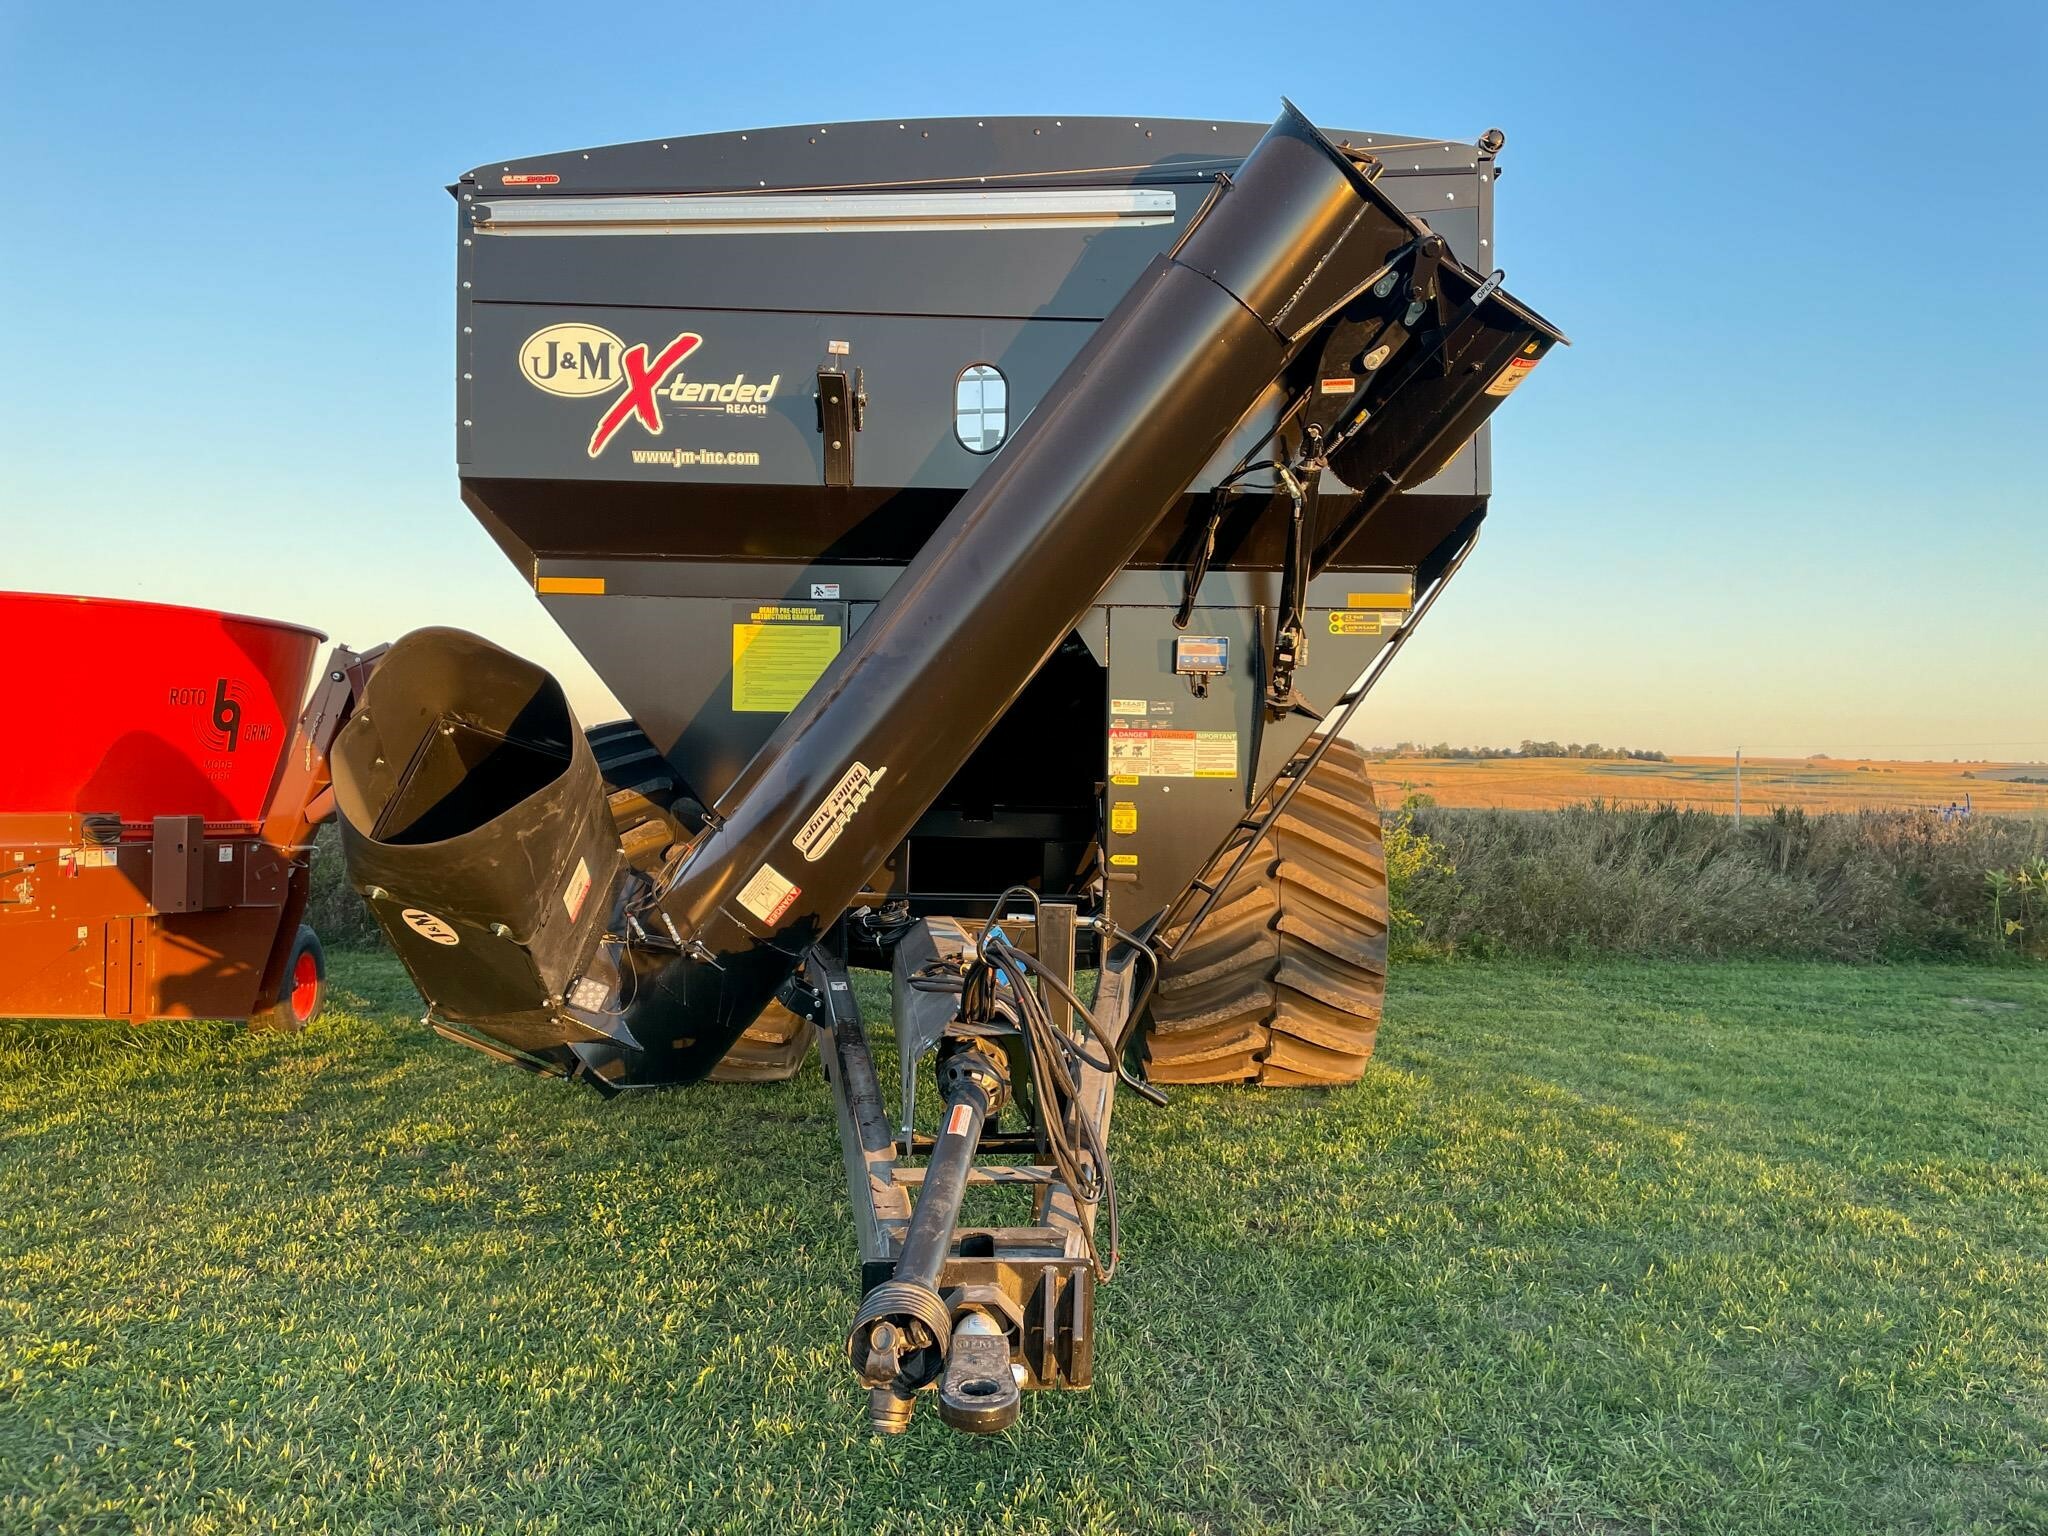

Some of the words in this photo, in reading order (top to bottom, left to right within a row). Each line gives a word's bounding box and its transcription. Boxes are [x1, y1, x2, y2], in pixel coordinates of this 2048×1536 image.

[1477, 280, 1494, 299] OPEN
[531, 341, 612, 380] J&M
[726, 404, 767, 414] REACH
[632, 449, 760, 467] www.jm-inc.com
[169, 688, 207, 706] ROTO
[244, 724, 272, 741] GRIND
[831, 769, 863, 807] Bullet
[800, 809, 832, 846] Auger
[767, 895, 793, 925] DANGER
[406, 914, 457, 943] J&M
